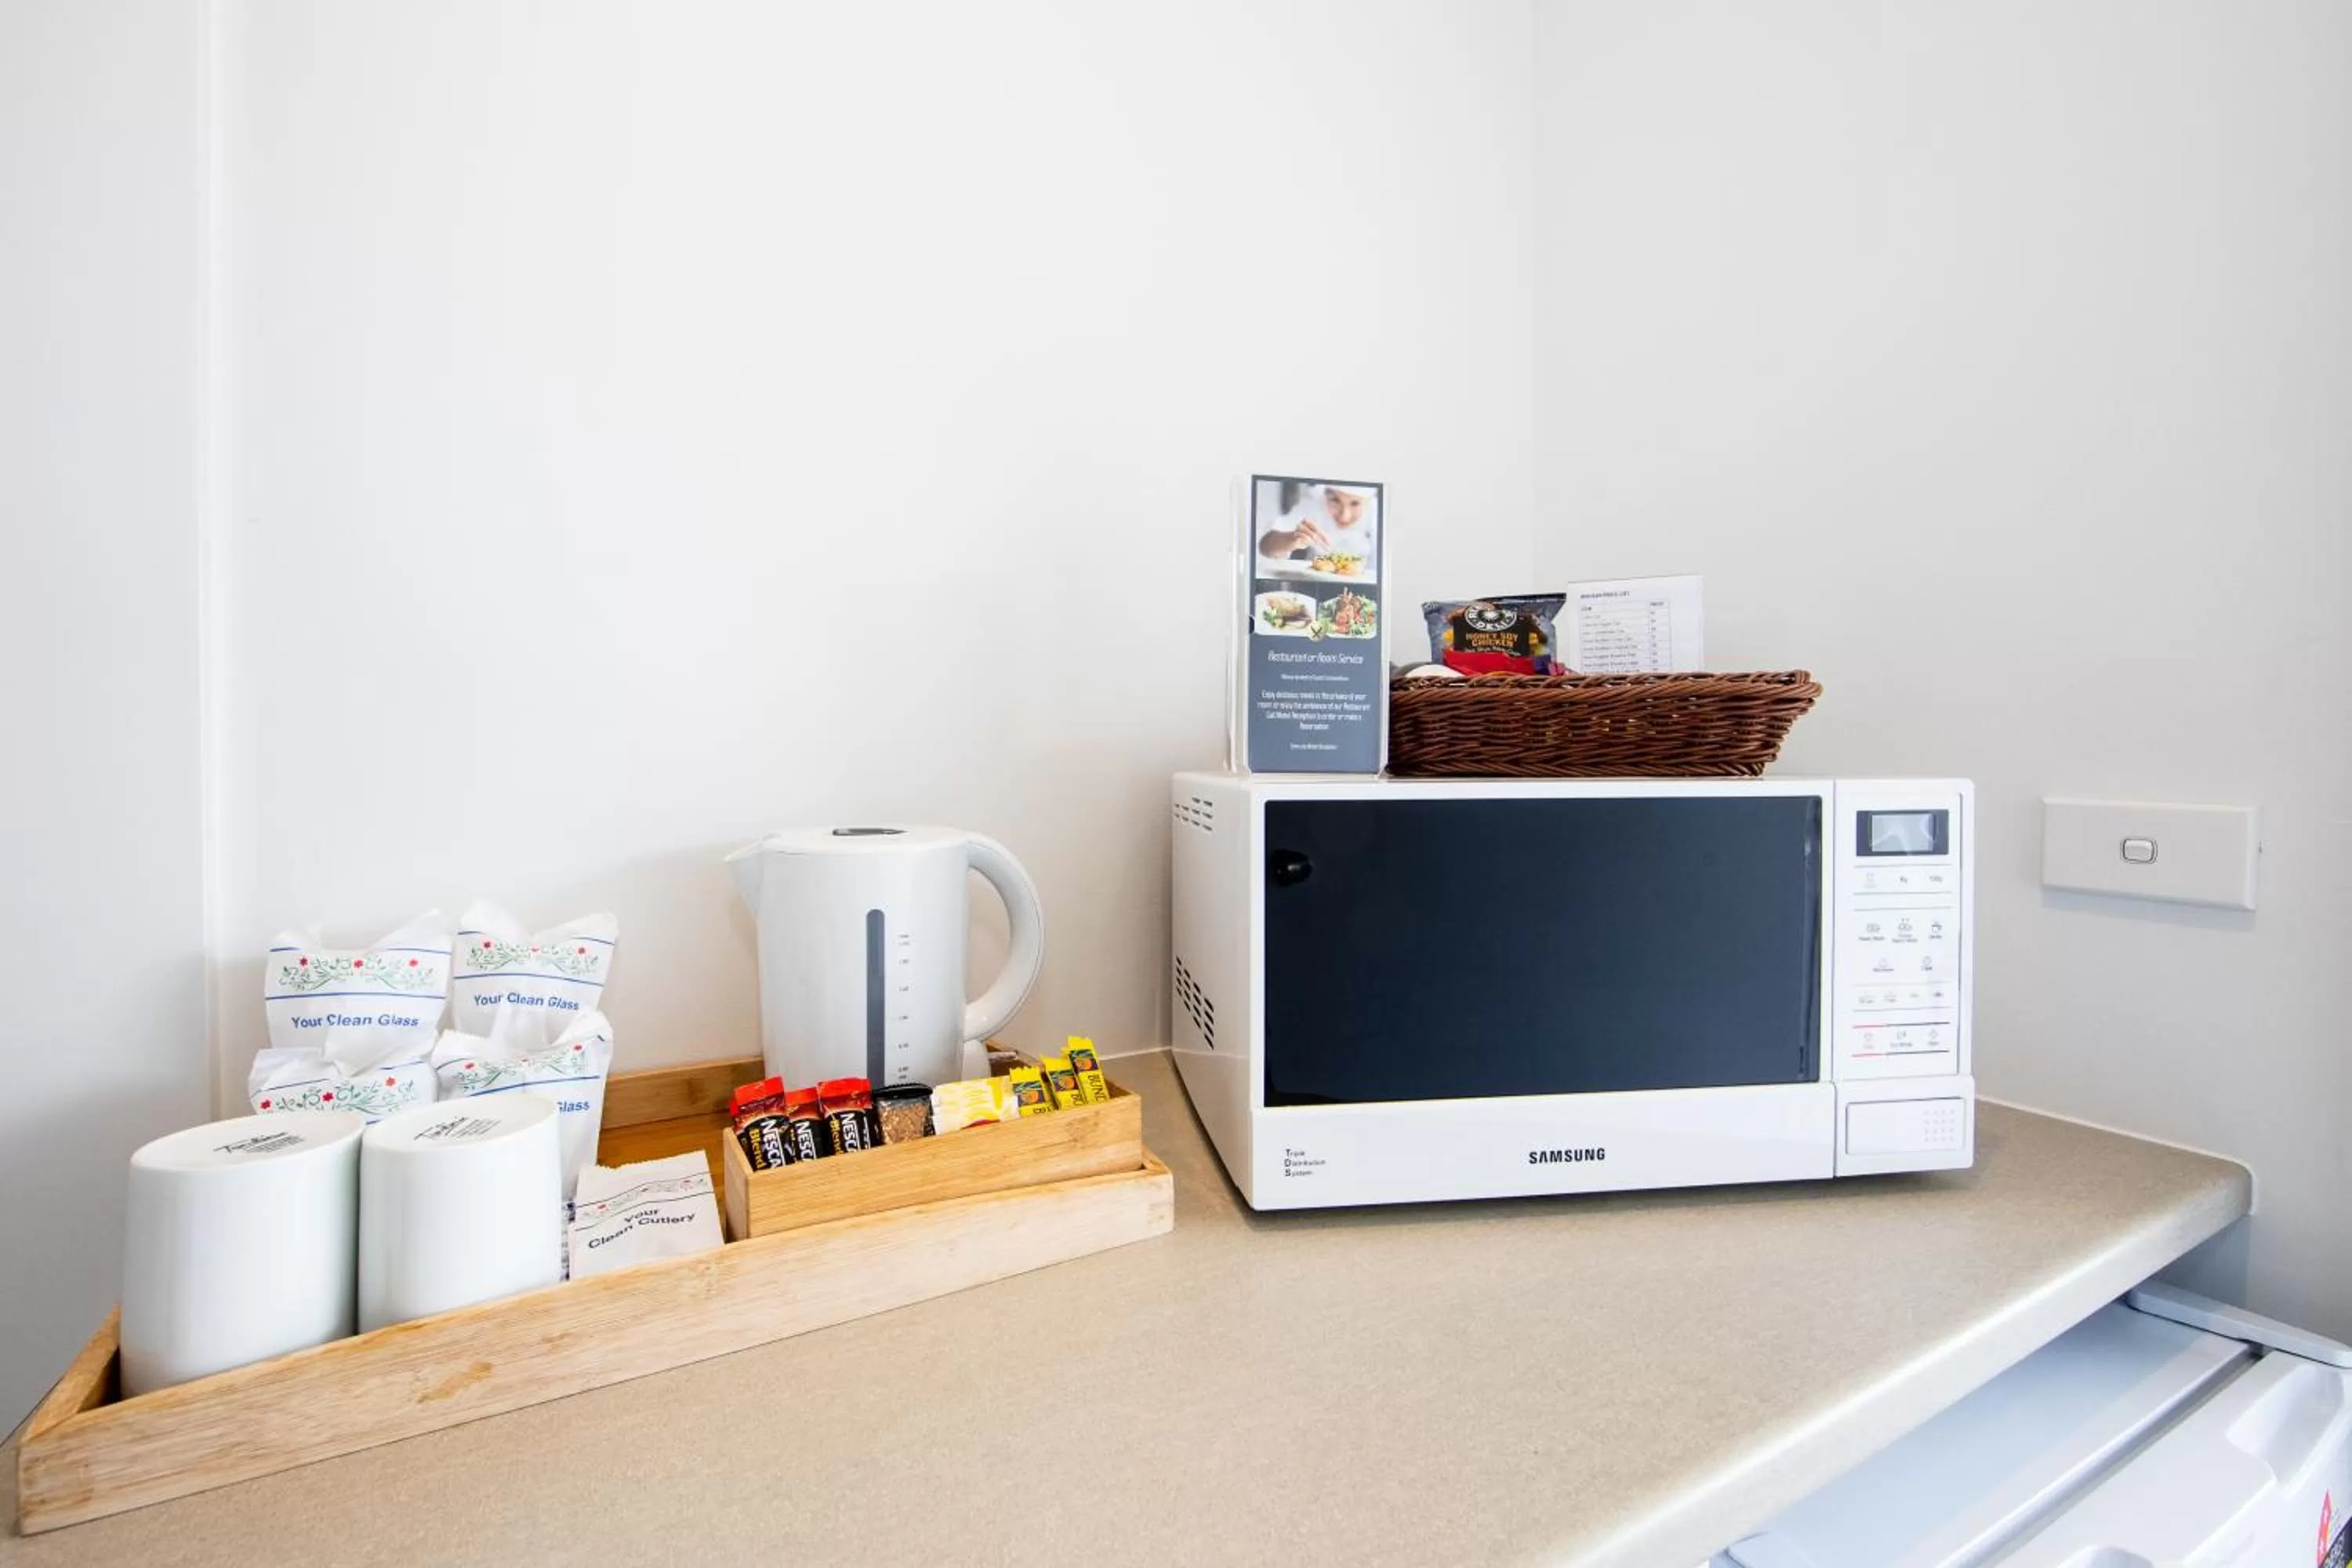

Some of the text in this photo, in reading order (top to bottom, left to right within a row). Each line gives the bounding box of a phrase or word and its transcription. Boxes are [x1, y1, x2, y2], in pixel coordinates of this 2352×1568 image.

[1268, 650, 1307, 662] Restaurant
[1337, 653, 1364, 665] Service
[474, 992, 579, 1011] Your Clean Glass
[292, 1013, 419, 1029] Your Clean Glass
[795, 1120, 816, 1162] NESC
[840, 1112, 862, 1153] NESC
[749, 1127, 769, 1170] Blend
[1529, 1148, 1606, 1165] SAMSUNG
[588, 1213, 696, 1250] Clean Cutlery
